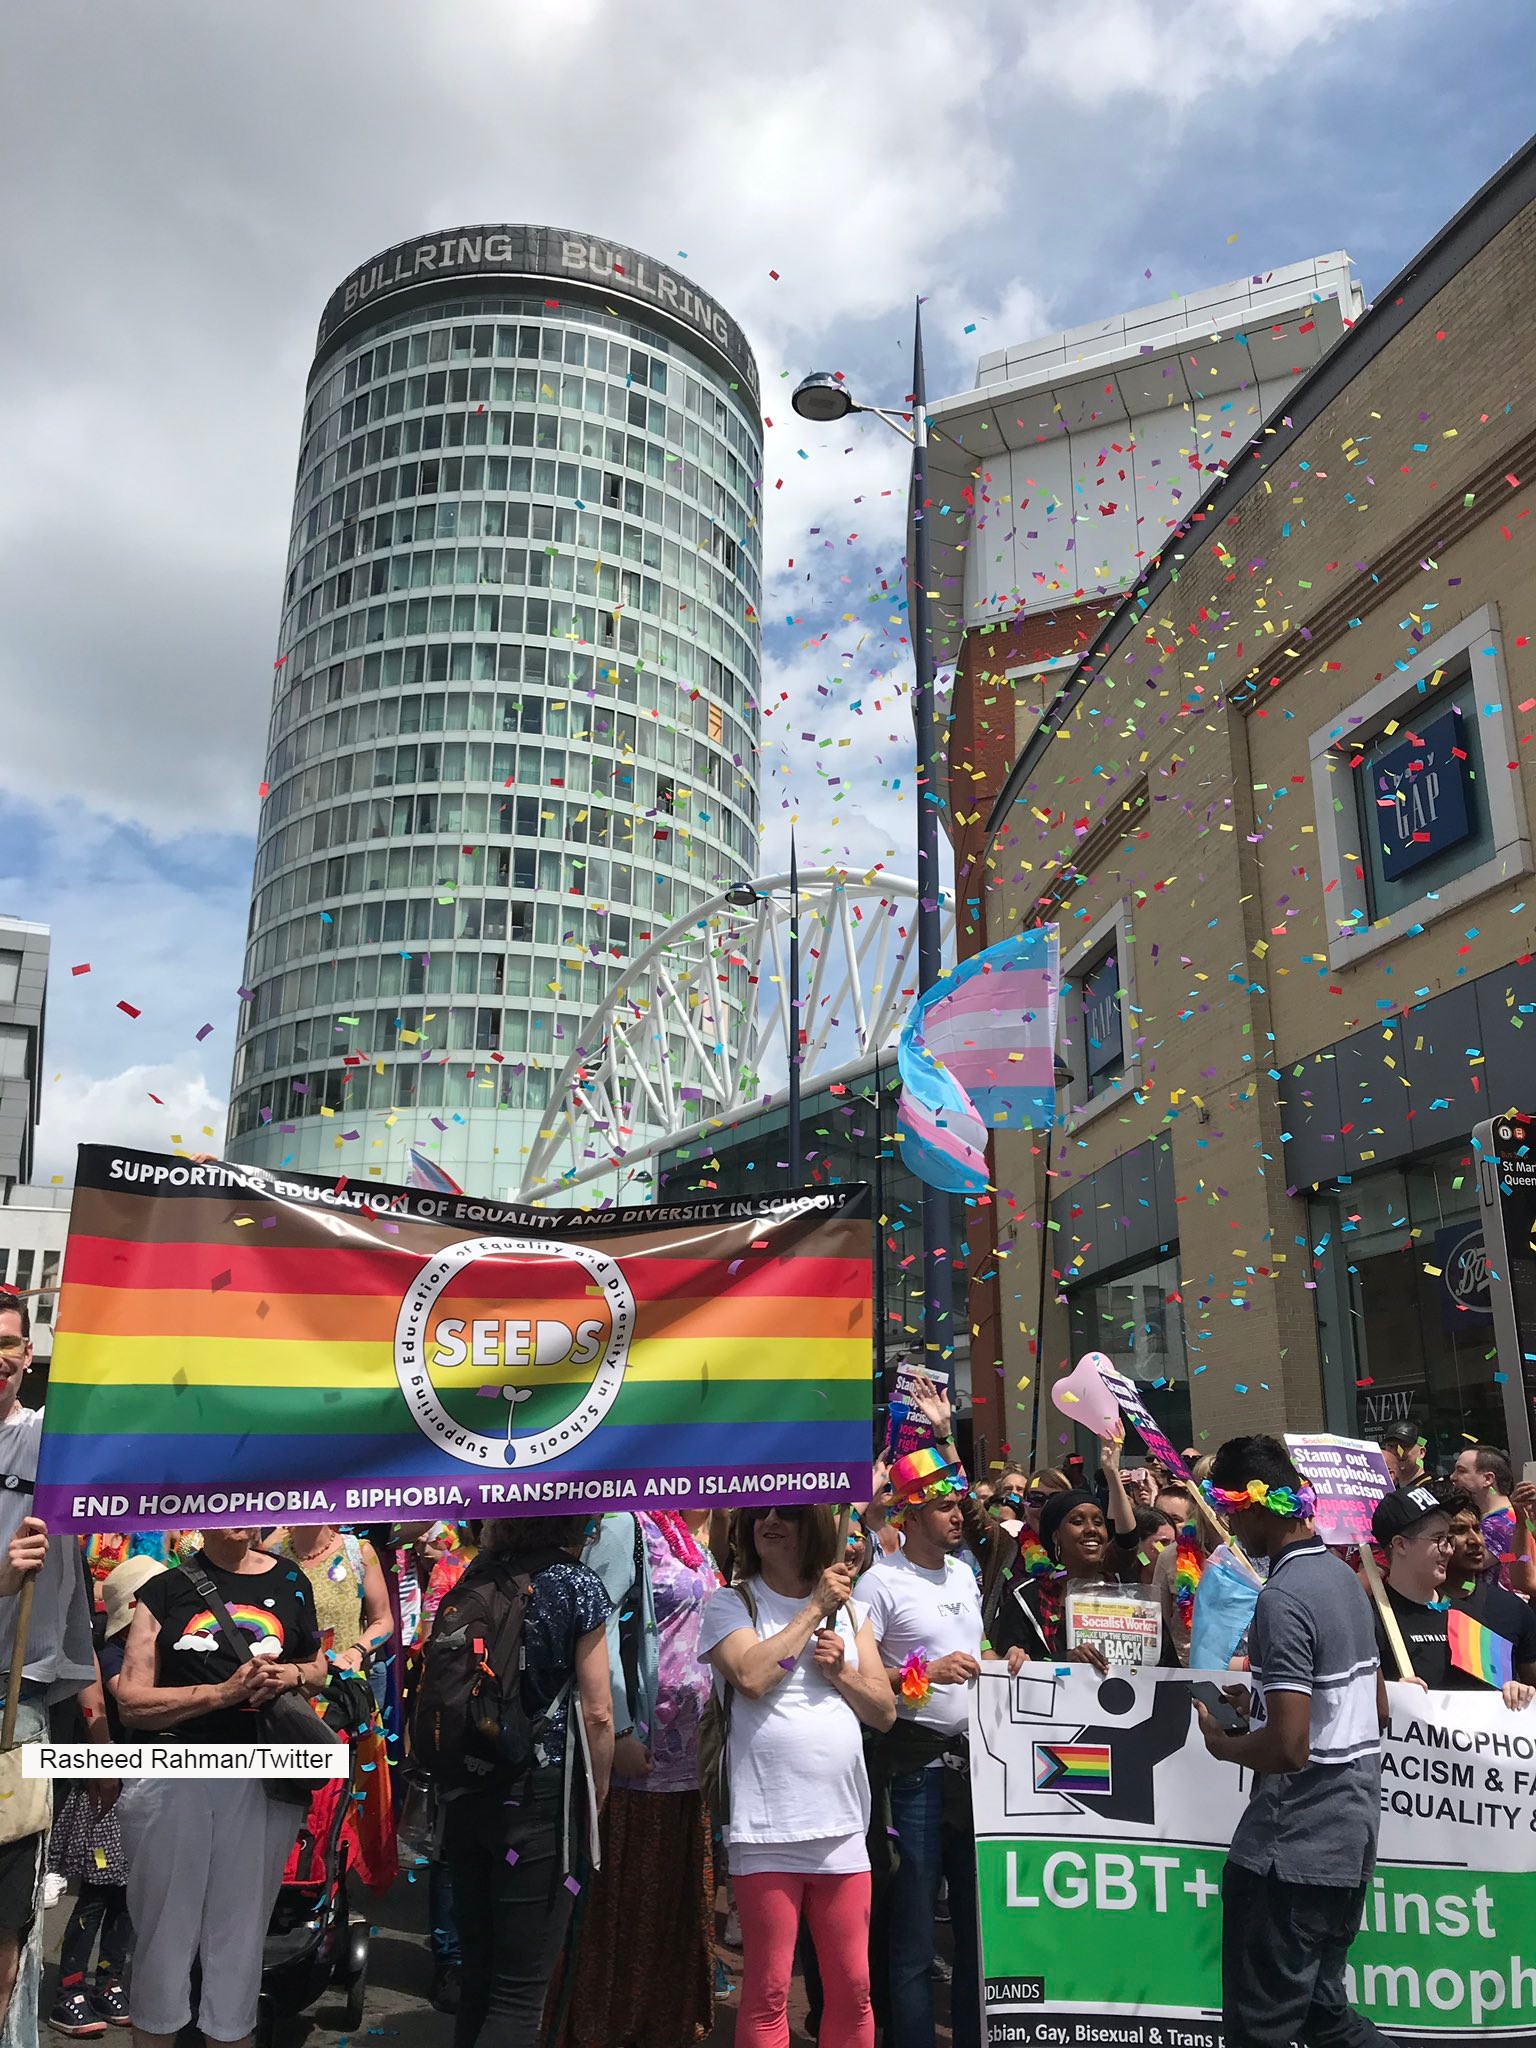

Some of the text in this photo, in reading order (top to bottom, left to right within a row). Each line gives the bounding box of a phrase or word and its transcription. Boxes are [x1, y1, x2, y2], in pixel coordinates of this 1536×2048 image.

[343, 234, 513, 313] BULLRING
[561, 240, 728, 348] BULLRING
[1395, 772, 1440, 840] GAP
[1502, 1161, 1514, 1172] St
[108, 1158, 846, 1229] SUPPORTING EDUCATION OF EQUALITY AND DIVERSITY IN SCHOOLS
[401, 1240, 627, 1459] Supporting Education of Equality and Diversity in Schools
[432, 1318, 604, 1367] SEEDS
[1364, 1390, 1416, 1424] NEW
[1293, 1447, 1370, 1468] Stamp out
[1298, 1463, 1388, 1486] homophobia
[71, 1471, 851, 1518] END HOMOPHOBIA, BIPHOBIA, TRANSPHOBIA AND ISLAMOPHOBIA
[1315, 1480, 1385, 1500] nd racism
[1316, 1497, 1367, 1514] ppose
[1081, 1615, 1158, 1632] Socialist Worker
[1099, 1631, 1109, 1639] UP
[1109, 1632, 1121, 1640] THE
[1105, 1640, 1142, 1660] BACK
[1410, 1634, 1424, 1642] YES
[1387, 1717, 1536, 1760] LAMOPHO
[1484, 1767, 1504, 1793] &
[1006, 1851, 1497, 1939] LGBT+ inst
[1035, 2024, 1071, 2045] Gay,
[1075, 2024, 1144, 2044] Bisexual
[1149, 2027, 1163, 2045] &
[1167, 2029, 1213, 2048] Trans
